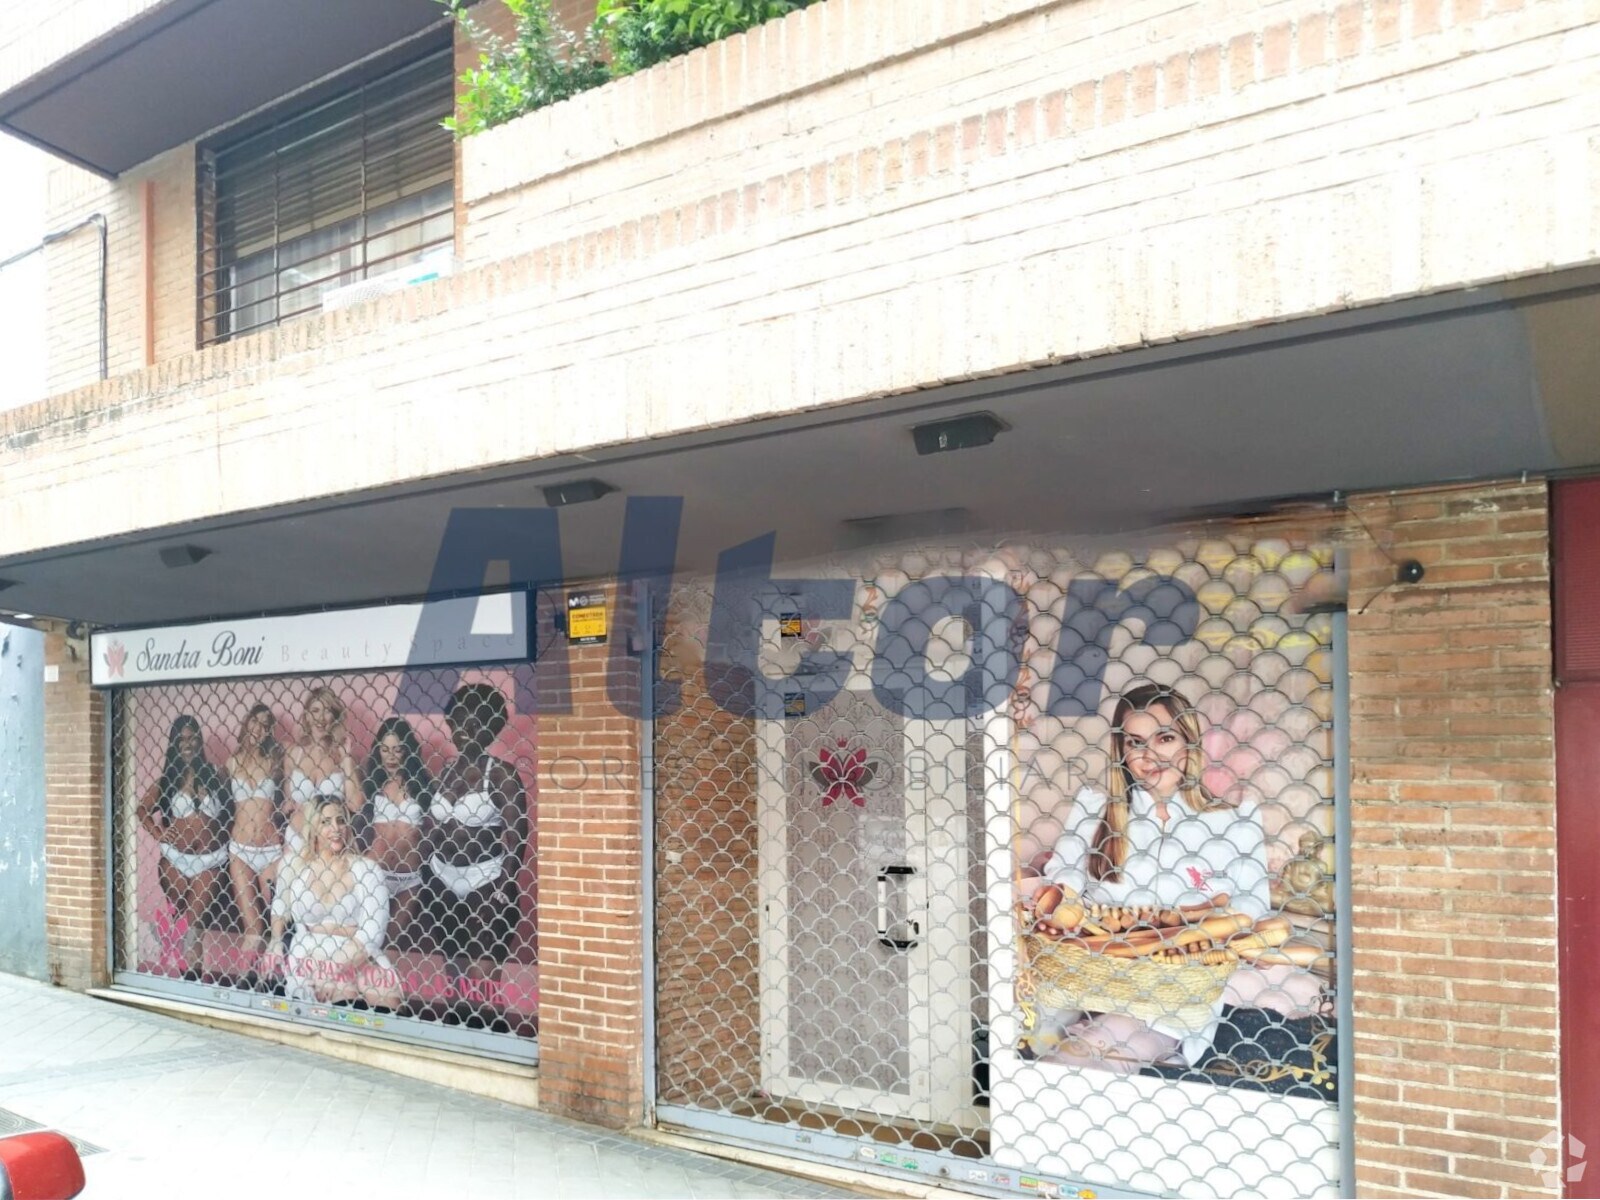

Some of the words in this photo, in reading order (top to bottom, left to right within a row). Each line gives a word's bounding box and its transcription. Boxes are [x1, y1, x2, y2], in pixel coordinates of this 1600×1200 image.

[136, 637, 200, 672] Sandra
[207, 630, 265, 667] Boni
[280, 640, 391, 662] Beauty
[408, 632, 515, 660] Space
